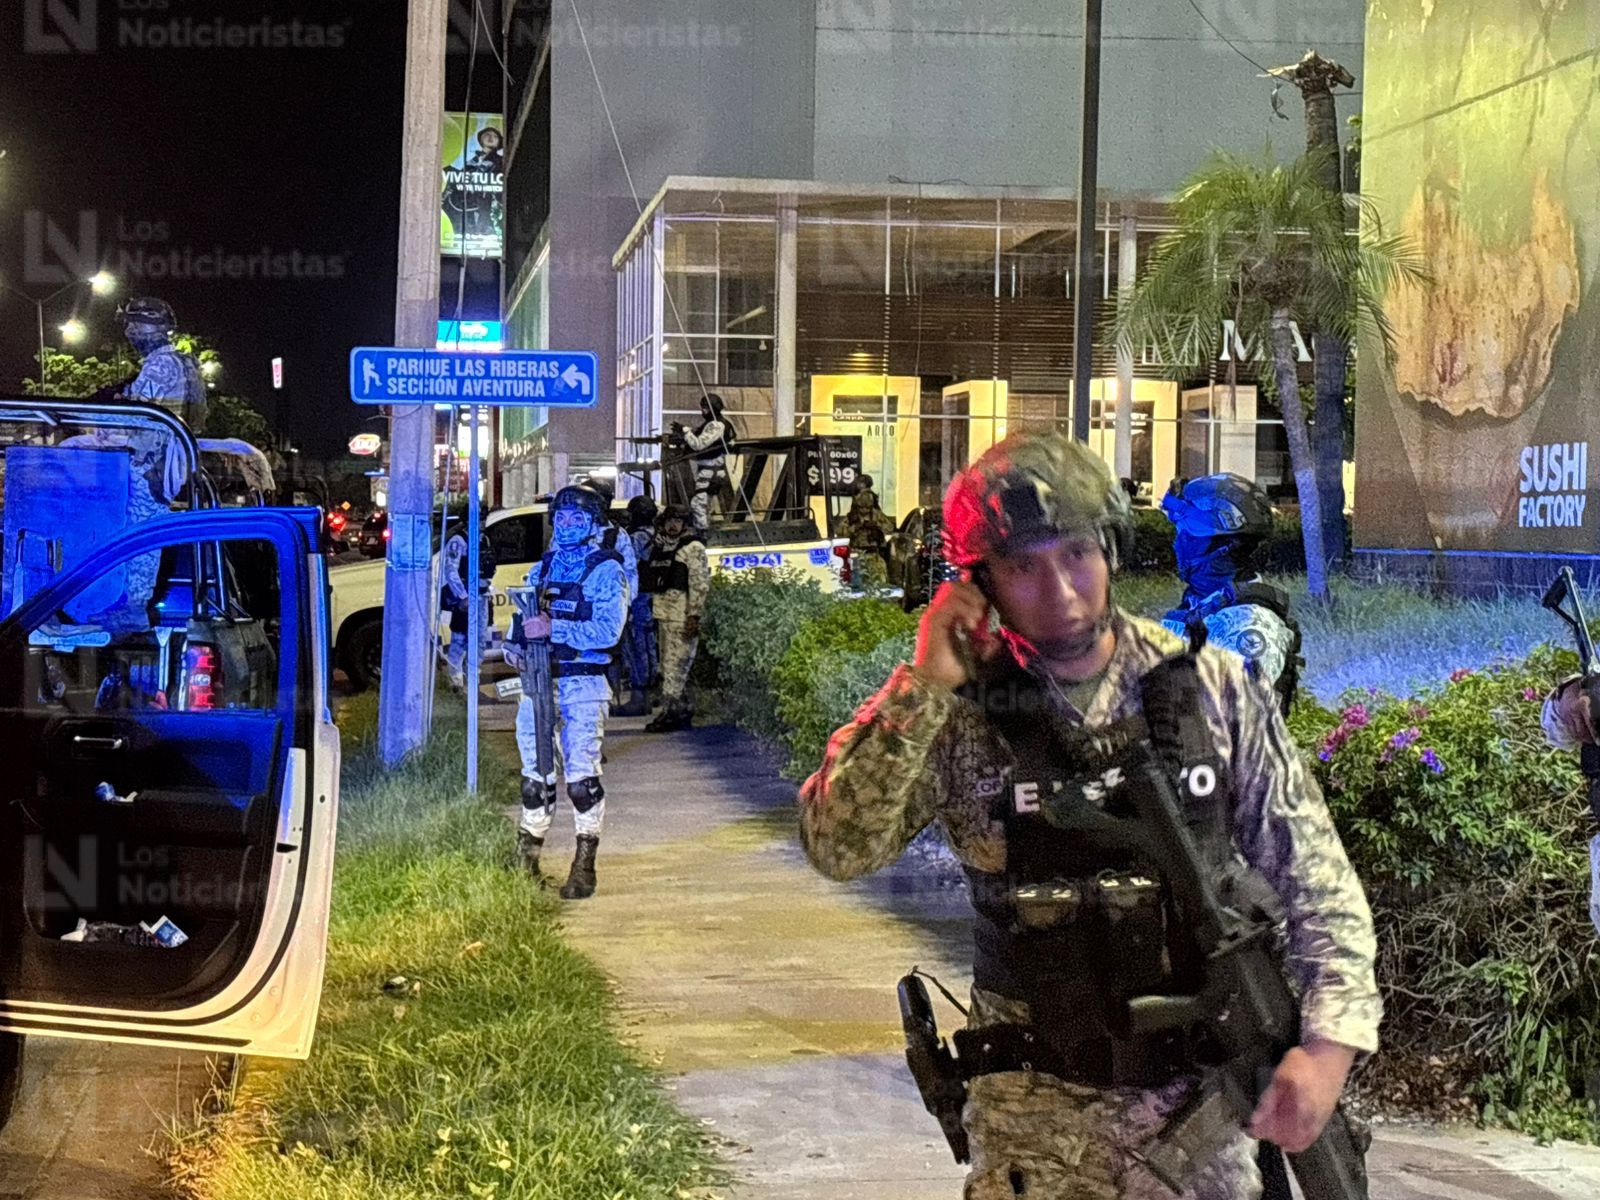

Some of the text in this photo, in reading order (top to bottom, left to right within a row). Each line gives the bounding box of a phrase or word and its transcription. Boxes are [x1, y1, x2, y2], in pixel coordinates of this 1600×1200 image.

[472, 171, 488, 184] TU
[387, 357, 560, 379] PARQUE LAS RIBERAS
[386, 375, 546, 397] SECCIÓN AVENTURA
[867, 424, 895, 437] ARO
[1519, 441, 1588, 493] SUSHI
[1518, 494, 1586, 528] FACTORY
